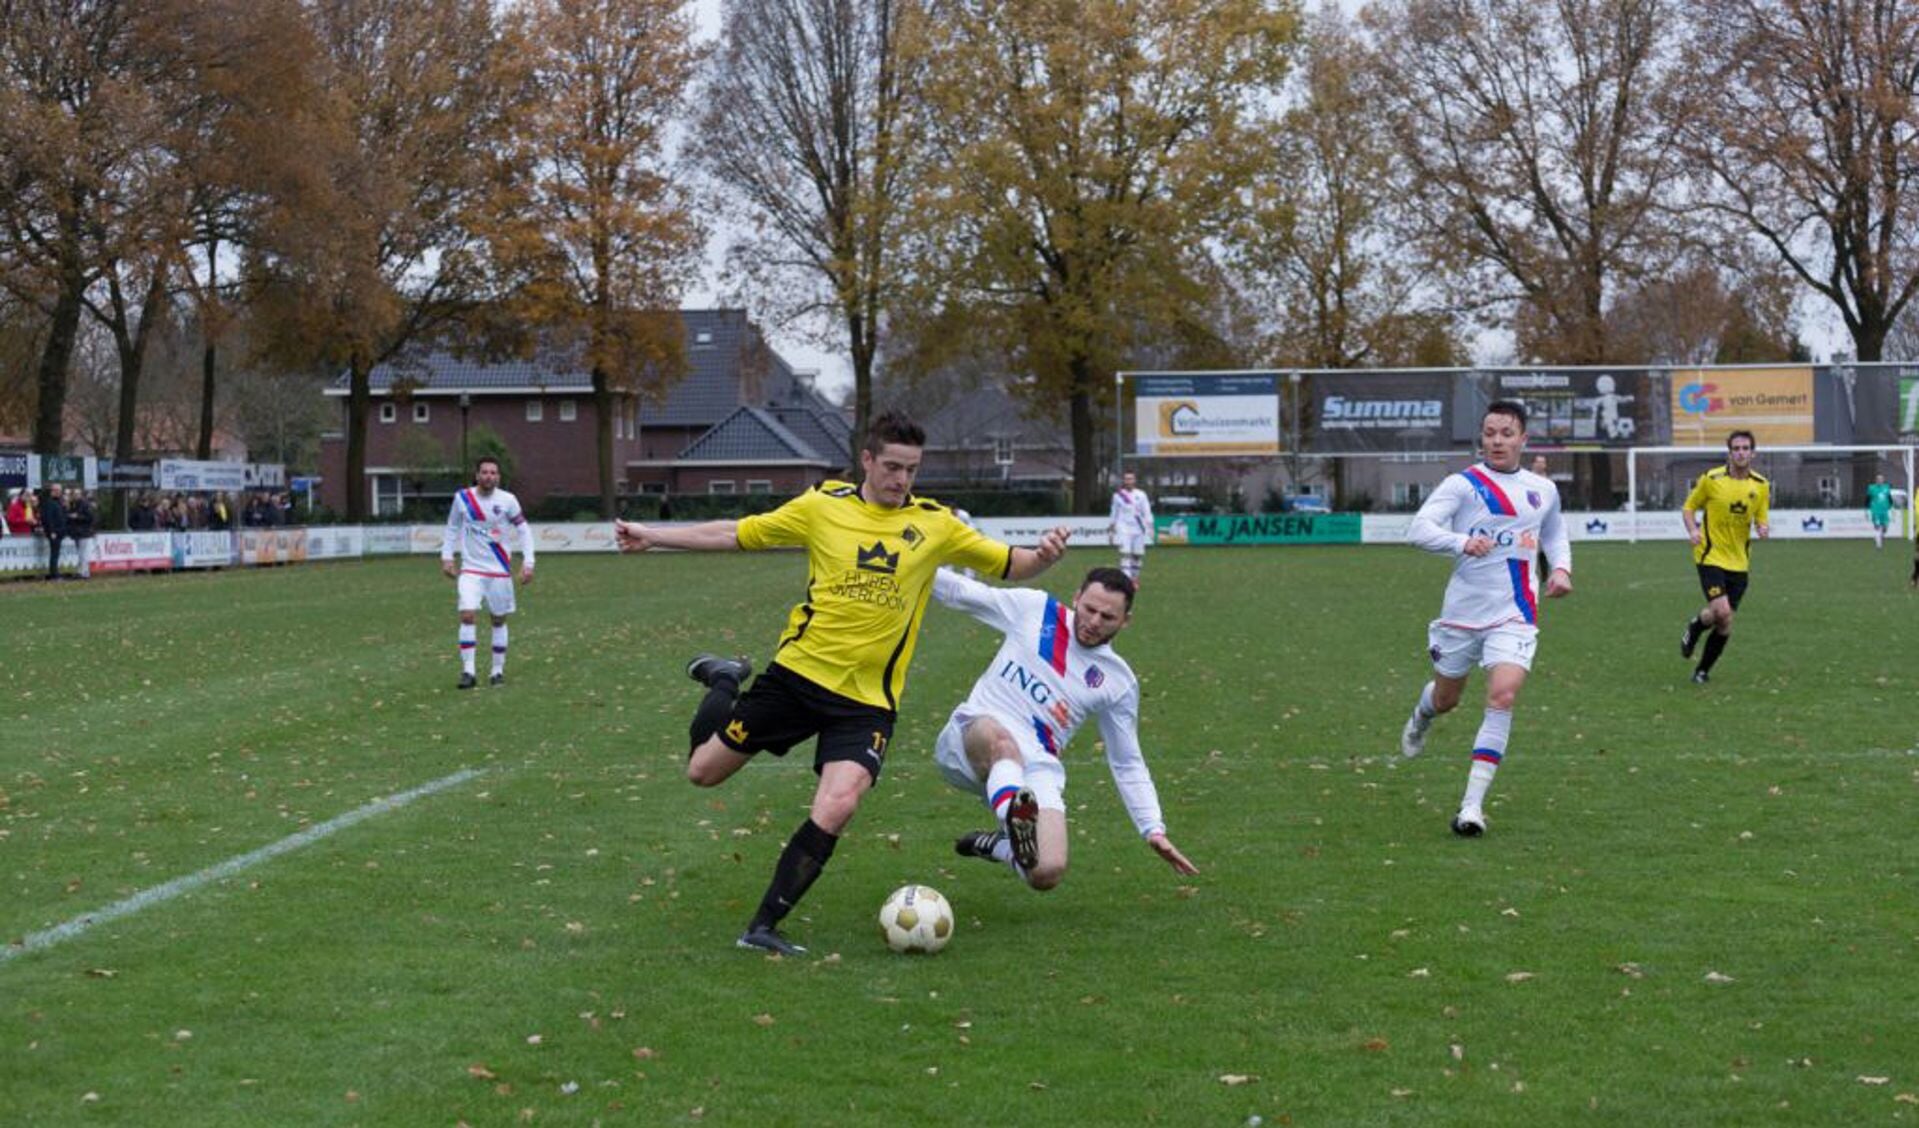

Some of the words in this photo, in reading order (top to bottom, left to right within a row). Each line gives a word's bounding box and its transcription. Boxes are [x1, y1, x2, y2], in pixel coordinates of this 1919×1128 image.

[1322, 396, 1442, 418] Summa
[1756, 394, 1808, 406] Gemert
[1197, 518, 1222, 536] M.
[1226, 517, 1314, 541] JANSEN
[1468, 528, 1513, 547] ING
[845, 571, 901, 594] HUREN
[1000, 660, 1052, 705] ING
